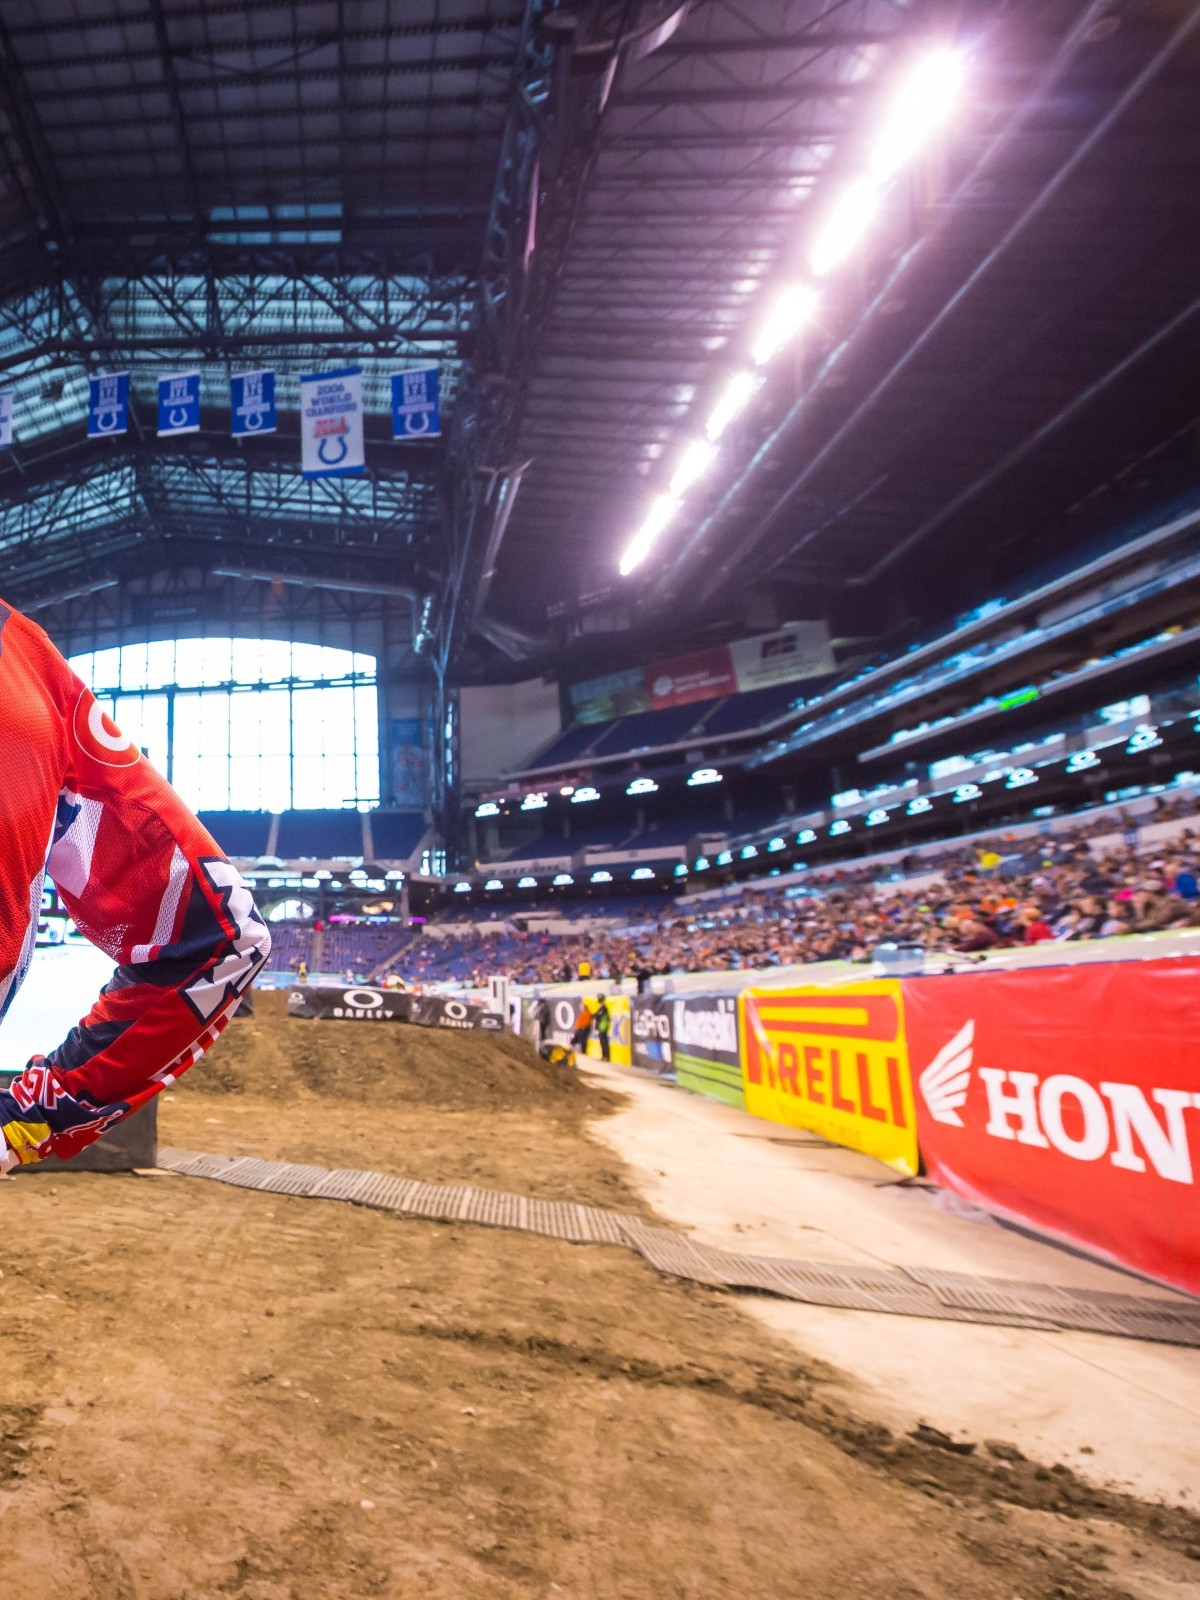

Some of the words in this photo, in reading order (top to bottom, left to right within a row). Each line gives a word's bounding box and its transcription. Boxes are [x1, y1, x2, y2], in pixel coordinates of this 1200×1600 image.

[333, 1007, 394, 1019] OAKLEY
[745, 995, 908, 1130] PIRELLI
[978, 1066, 1200, 1184] HON
